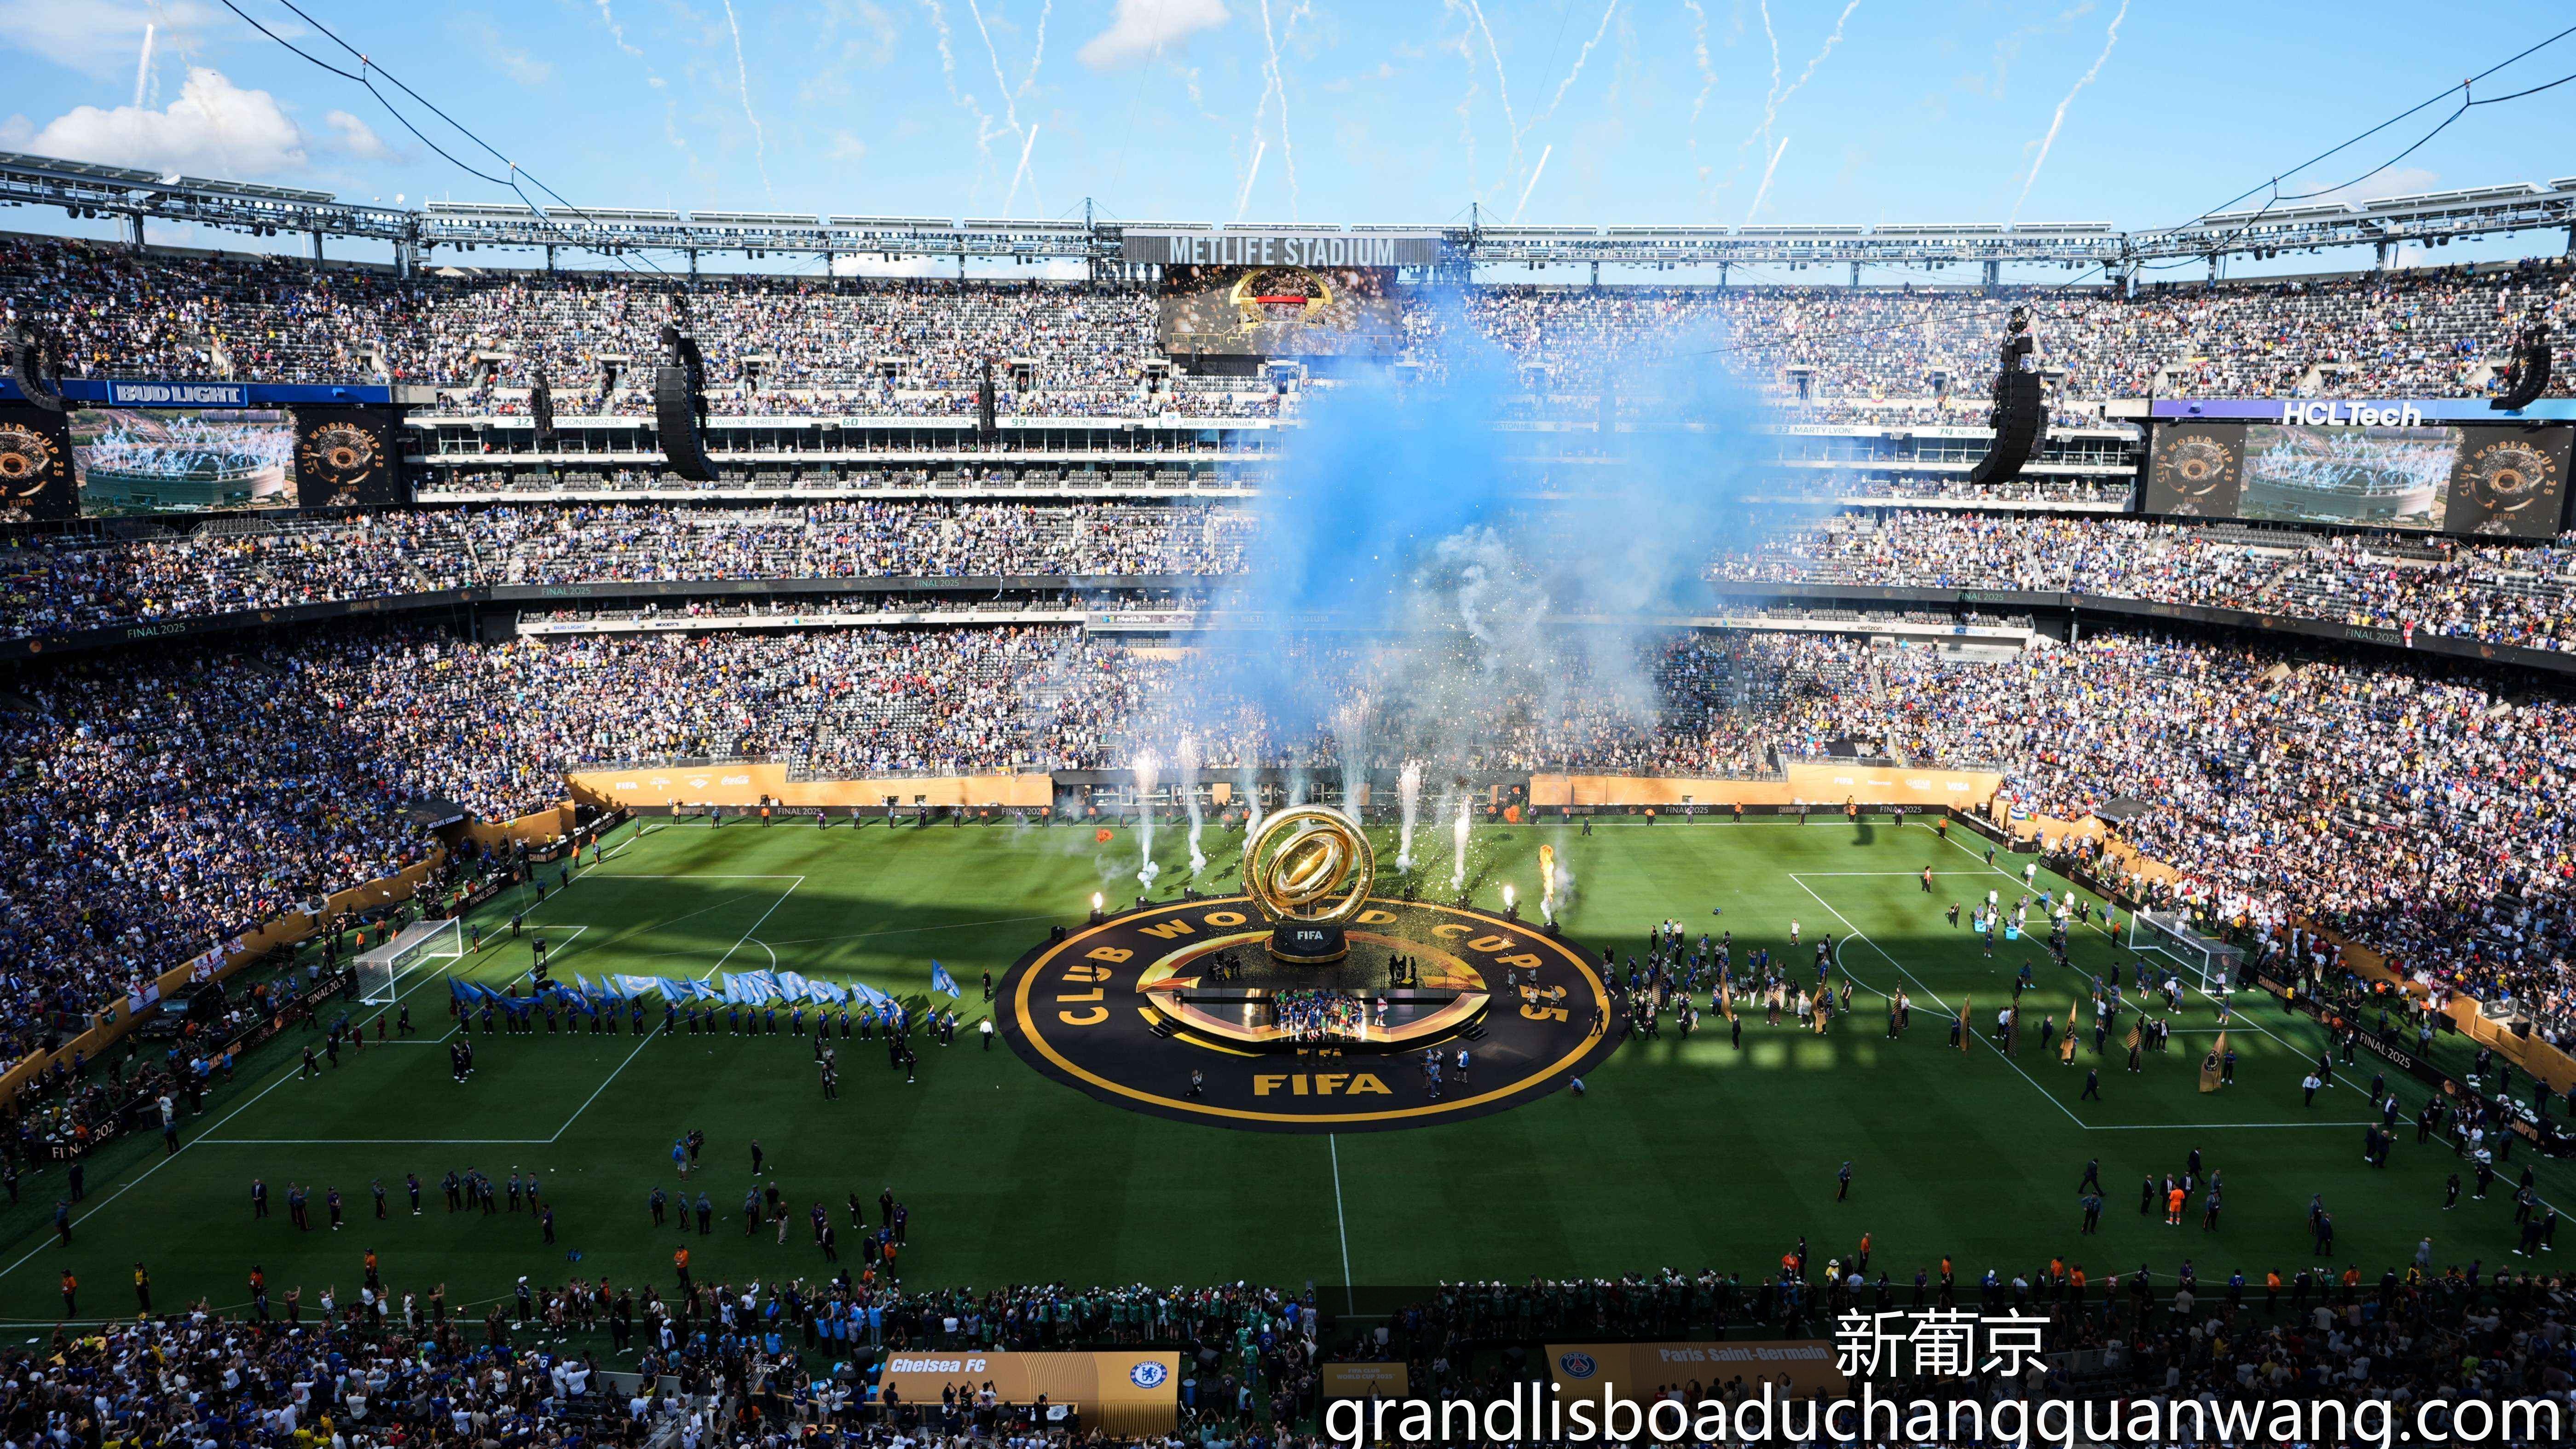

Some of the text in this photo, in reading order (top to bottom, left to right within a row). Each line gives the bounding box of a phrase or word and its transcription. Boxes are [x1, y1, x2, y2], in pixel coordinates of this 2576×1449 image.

[1170, 237, 1394, 266] METLIFE STADIUM
[116, 385, 240, 403] BUD LIGHT
[2282, 402, 2422, 426] HCLTech
[33, 431, 59, 454] CUP
[53, 461, 64, 477] 25
[302, 421, 384, 474] CLUB WORLD CUP 25
[2156, 435, 2235, 483] CLUB WORLD CUP 25
[2459, 440, 2557, 497] CLUB WORLD CUP 25
[8, 497, 35, 507] FIFA
[127, 623, 185, 638] FINAL 2025
[2346, 628, 2400, 643] FINAL 2025
[616, 782, 638, 790] FIFA
[721, 775, 750, 785] Coca-Cola
[1833, 777, 1854, 785] FIFA
[1946, 780, 1970, 791] VISA
[427, 814, 463, 829] METLIFE STADIUM
[2109, 814, 2121, 823] STADI
[470, 883, 498, 906] FINAL 2025
[1297, 930, 1323, 941] FIFA
[1056, 946, 1133, 1026] CLUB
[1138, 909, 1398, 940] WOD
[1431, 924, 1543, 969] CUP
[308, 987, 329, 1004] FINAL
[2258, 975, 2287, 999] CHAMPION
[208, 1041, 242, 1070] HAMIONS
[2360, 1032, 2411, 1068] FINAL 2025
[1254, 1074, 1393, 1096] FIFA
[94, 1120, 114, 1141] 202
[2511, 1118, 2539, 1141] AMPIO
[1659, 1345, 1829, 1362] Paris Saint-Germain
[539, 1359, 548, 1368] 10
[890, 1359, 987, 1373] Chelsea FC
